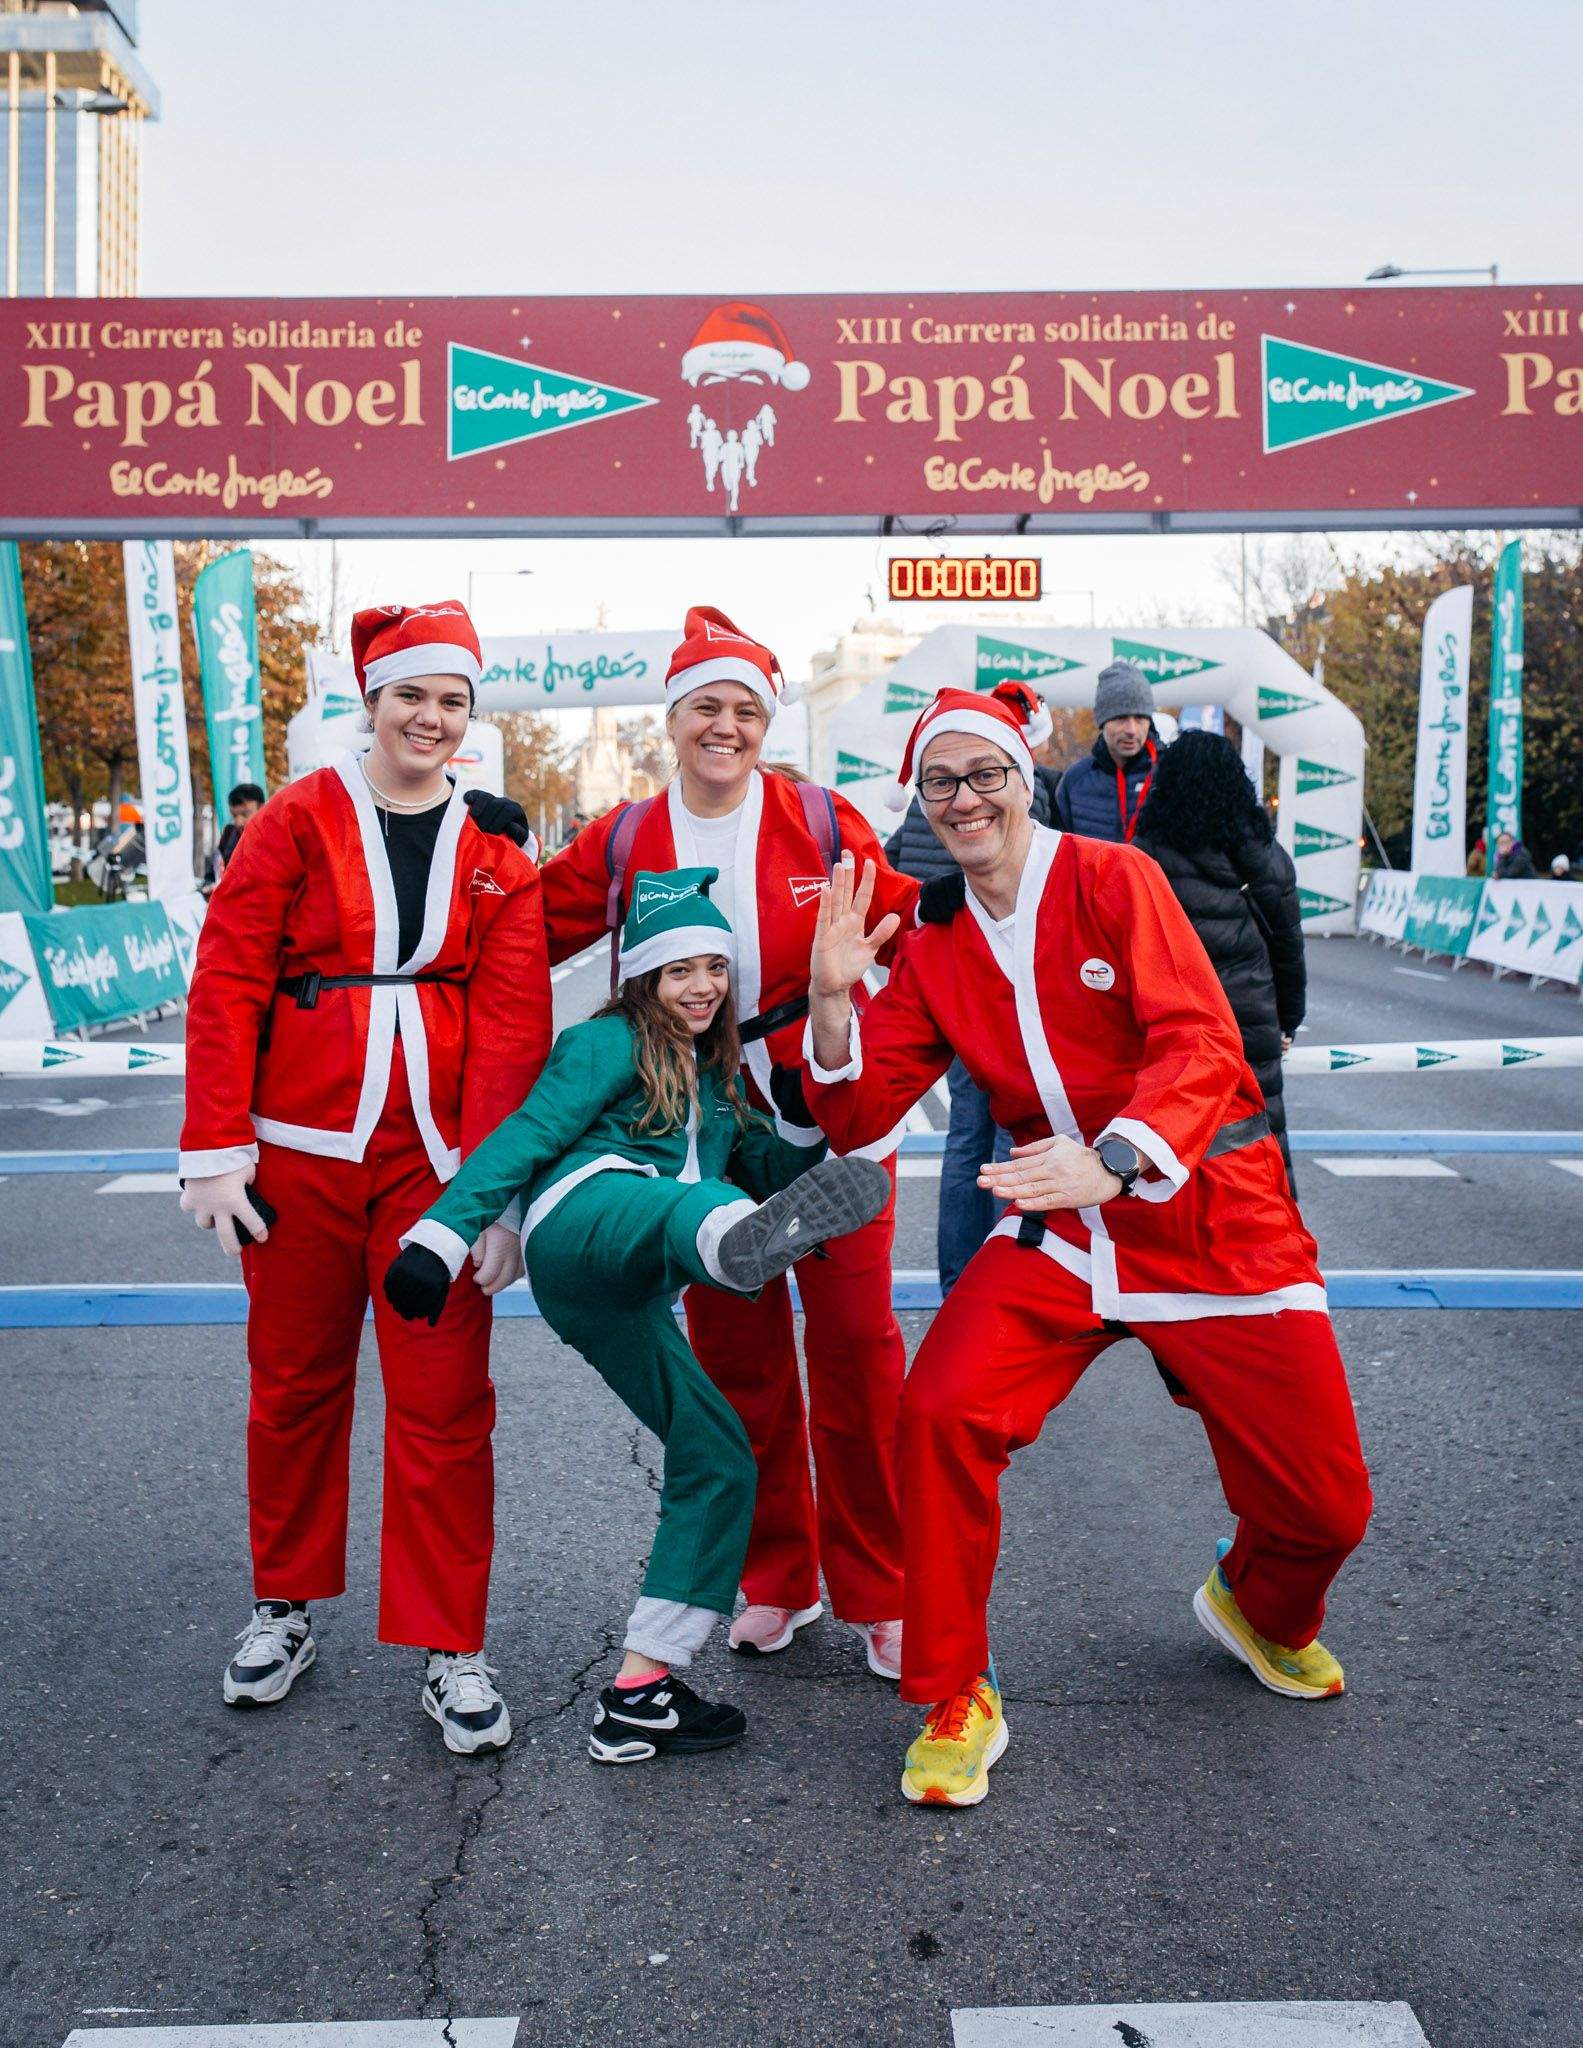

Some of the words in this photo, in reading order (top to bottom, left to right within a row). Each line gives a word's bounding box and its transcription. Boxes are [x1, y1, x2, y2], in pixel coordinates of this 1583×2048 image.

[26, 322, 93, 349] XIII
[100, 321, 224, 349] Carrera
[233, 320, 376, 348] solidaria
[384, 320, 423, 348] de
[836, 317, 903, 345] XIII
[911, 316, 1036, 344] Carrera
[1044, 313, 1189, 343] solidaria
[1196, 312, 1236, 341] de
[1502, 309, 1569, 337] XIII
[21, 359, 222, 448] Papá
[244, 359, 426, 427] Noel
[453, 384, 478, 411] El
[477, 385, 530, 411] Corte
[832, 354, 1036, 442] Papá
[1057, 351, 1242, 421] Noel
[1268, 376, 1293, 404] El
[1292, 377, 1346, 403] Corte
[109, 460, 144, 496] El
[144, 461, 220, 497] Corte
[222, 454, 334, 510] Inglés
[923, 455, 959, 492] El
[958, 457, 1036, 492] Corte
[1038, 448, 1150, 504] Inglés
[892, 560, 1037, 598] 00:00:00
[480, 657, 536, 684] orte
[544, 645, 647, 692] Inglés
